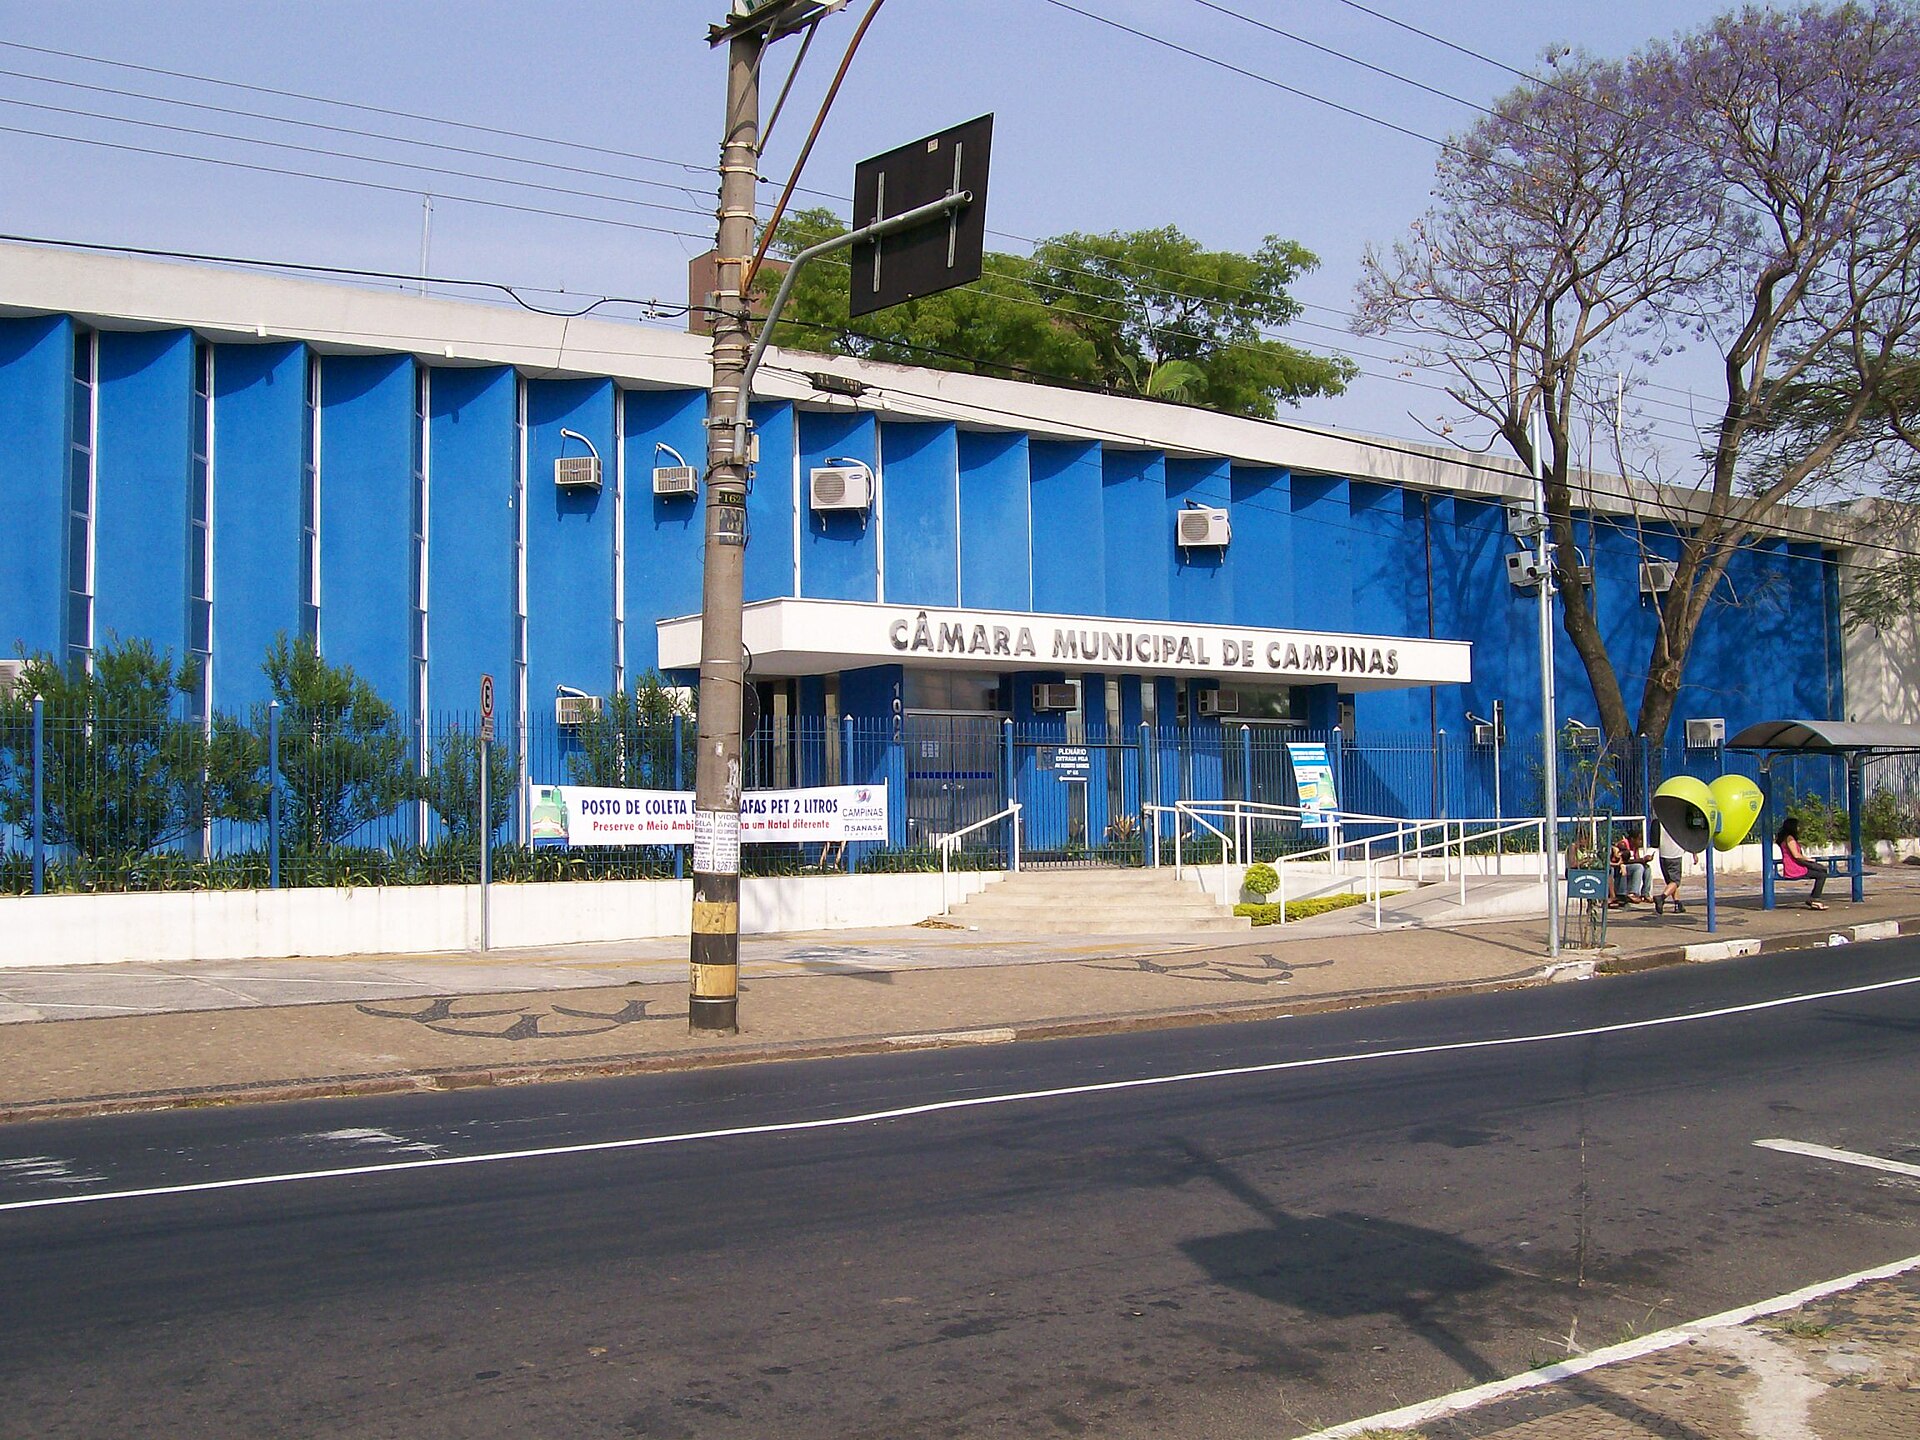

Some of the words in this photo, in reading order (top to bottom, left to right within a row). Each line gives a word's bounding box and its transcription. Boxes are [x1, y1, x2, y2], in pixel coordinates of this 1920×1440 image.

[889, 611, 1036, 656] CÂMARA
[1052, 629, 1210, 663] MUNICIPAL
[1222, 639, 1254, 667] DE
[1266, 641, 1398, 675] CAMPINAS
[582, 800, 620, 815] POSTO
[626, 800, 640, 815] DE
[646, 800, 687, 815] COLETA
[740, 799, 767, 814] AFAS
[771, 800, 789, 814] PET
[793, 800, 800, 813] 2
[804, 799, 838, 813] LITROS
[842, 808, 884, 817] CAMPINAS
[593, 821, 634, 831] Preserve
[637, 823, 643, 831] o
[647, 821, 668, 831] Meio
[672, 820, 694, 831] Ambi
[752, 822, 765, 830] um
[768, 819, 790, 830] Natal
[792, 819, 830, 829] diferente
[850, 824, 883, 832] SANASA
